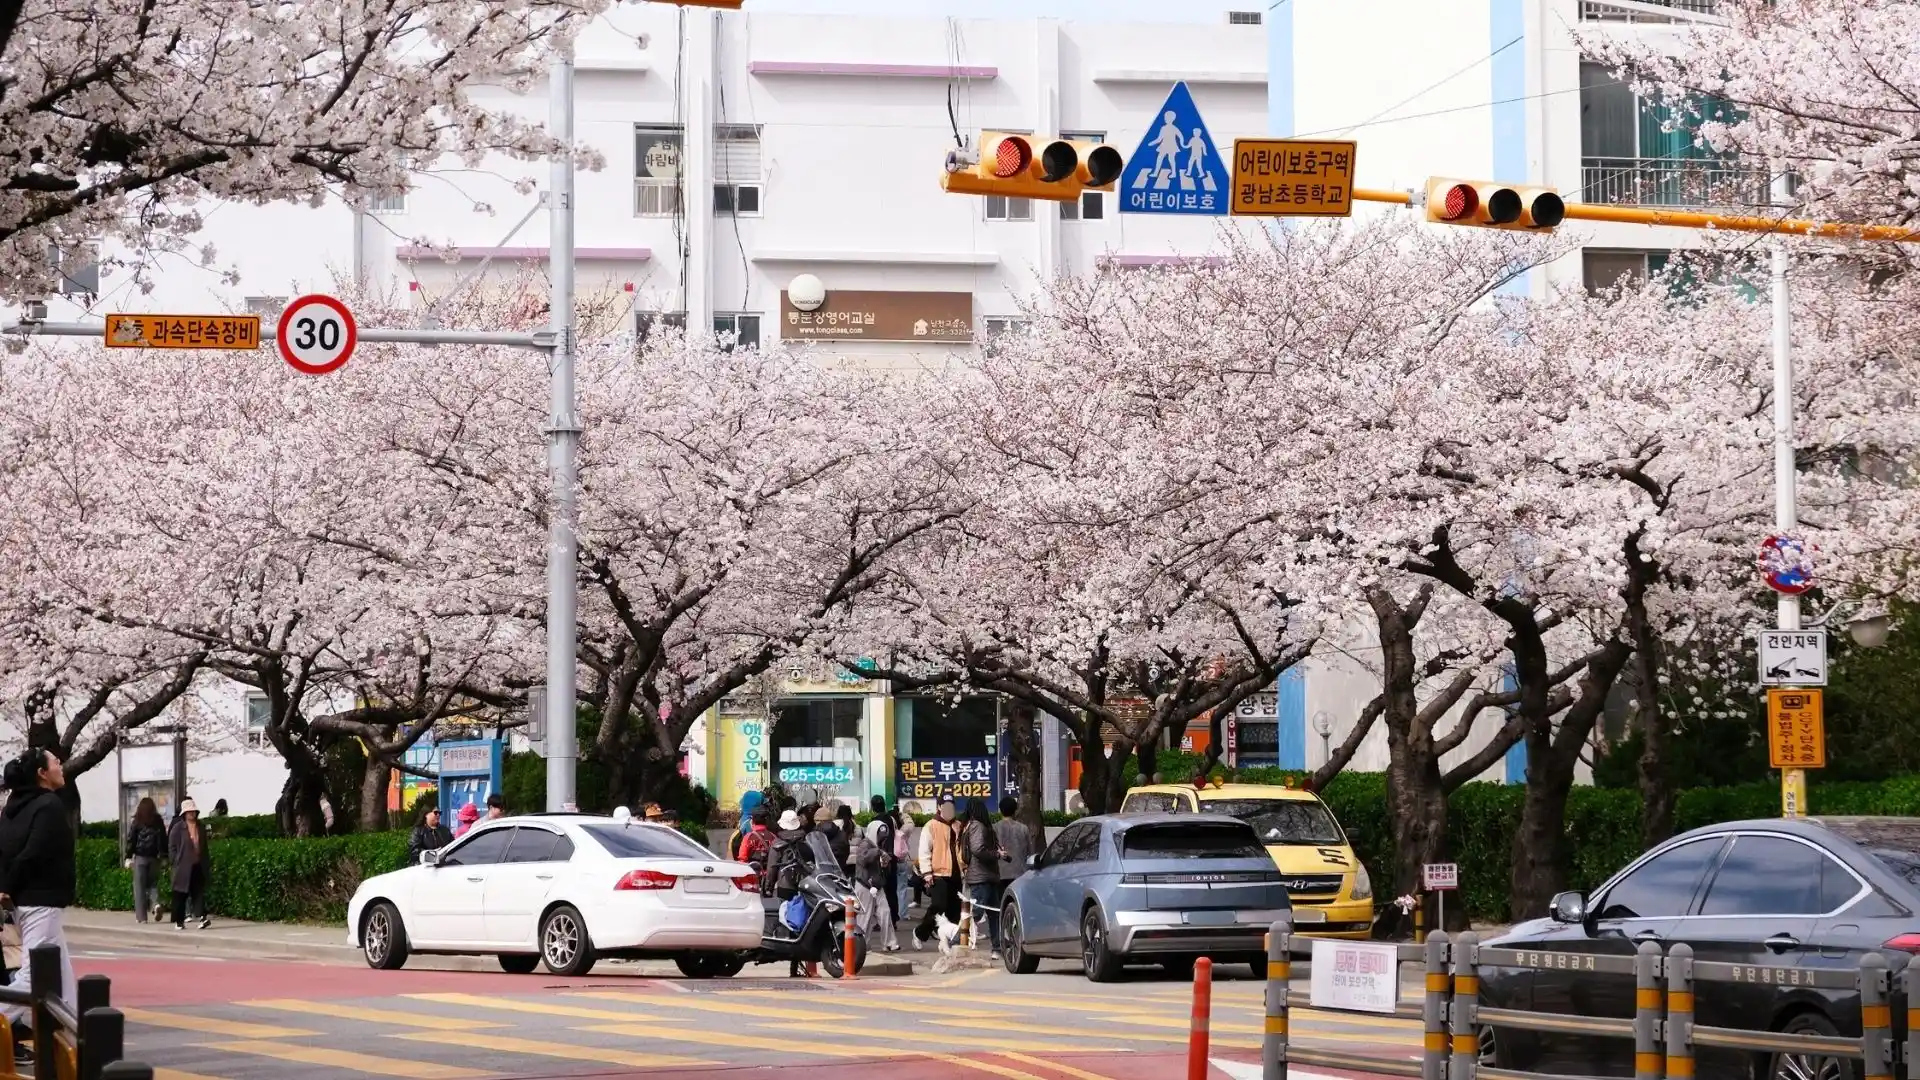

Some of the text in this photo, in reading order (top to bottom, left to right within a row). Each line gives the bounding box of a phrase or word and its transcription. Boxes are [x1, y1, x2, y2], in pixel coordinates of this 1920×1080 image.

[1240, 149, 1349, 178] 어린이보호구역
[1131, 192, 1216, 210] 어린이보호
[1240, 183, 1344, 206] 광남초등학교
[153, 319, 254, 345] 과속단속장비
[295, 317, 340, 351] 30
[1767, 634, 1819, 650] 견인지역
[743, 722, 762, 773] 행운
[779, 767, 854, 782] 625-5454
[901, 759, 992, 781] 랜드 부동산
[914, 783, 992, 797] 627-2022
[1516, 952, 1596, 971] 무단횡단금지
[1732, 967, 1816, 986] 무단횡단금지
